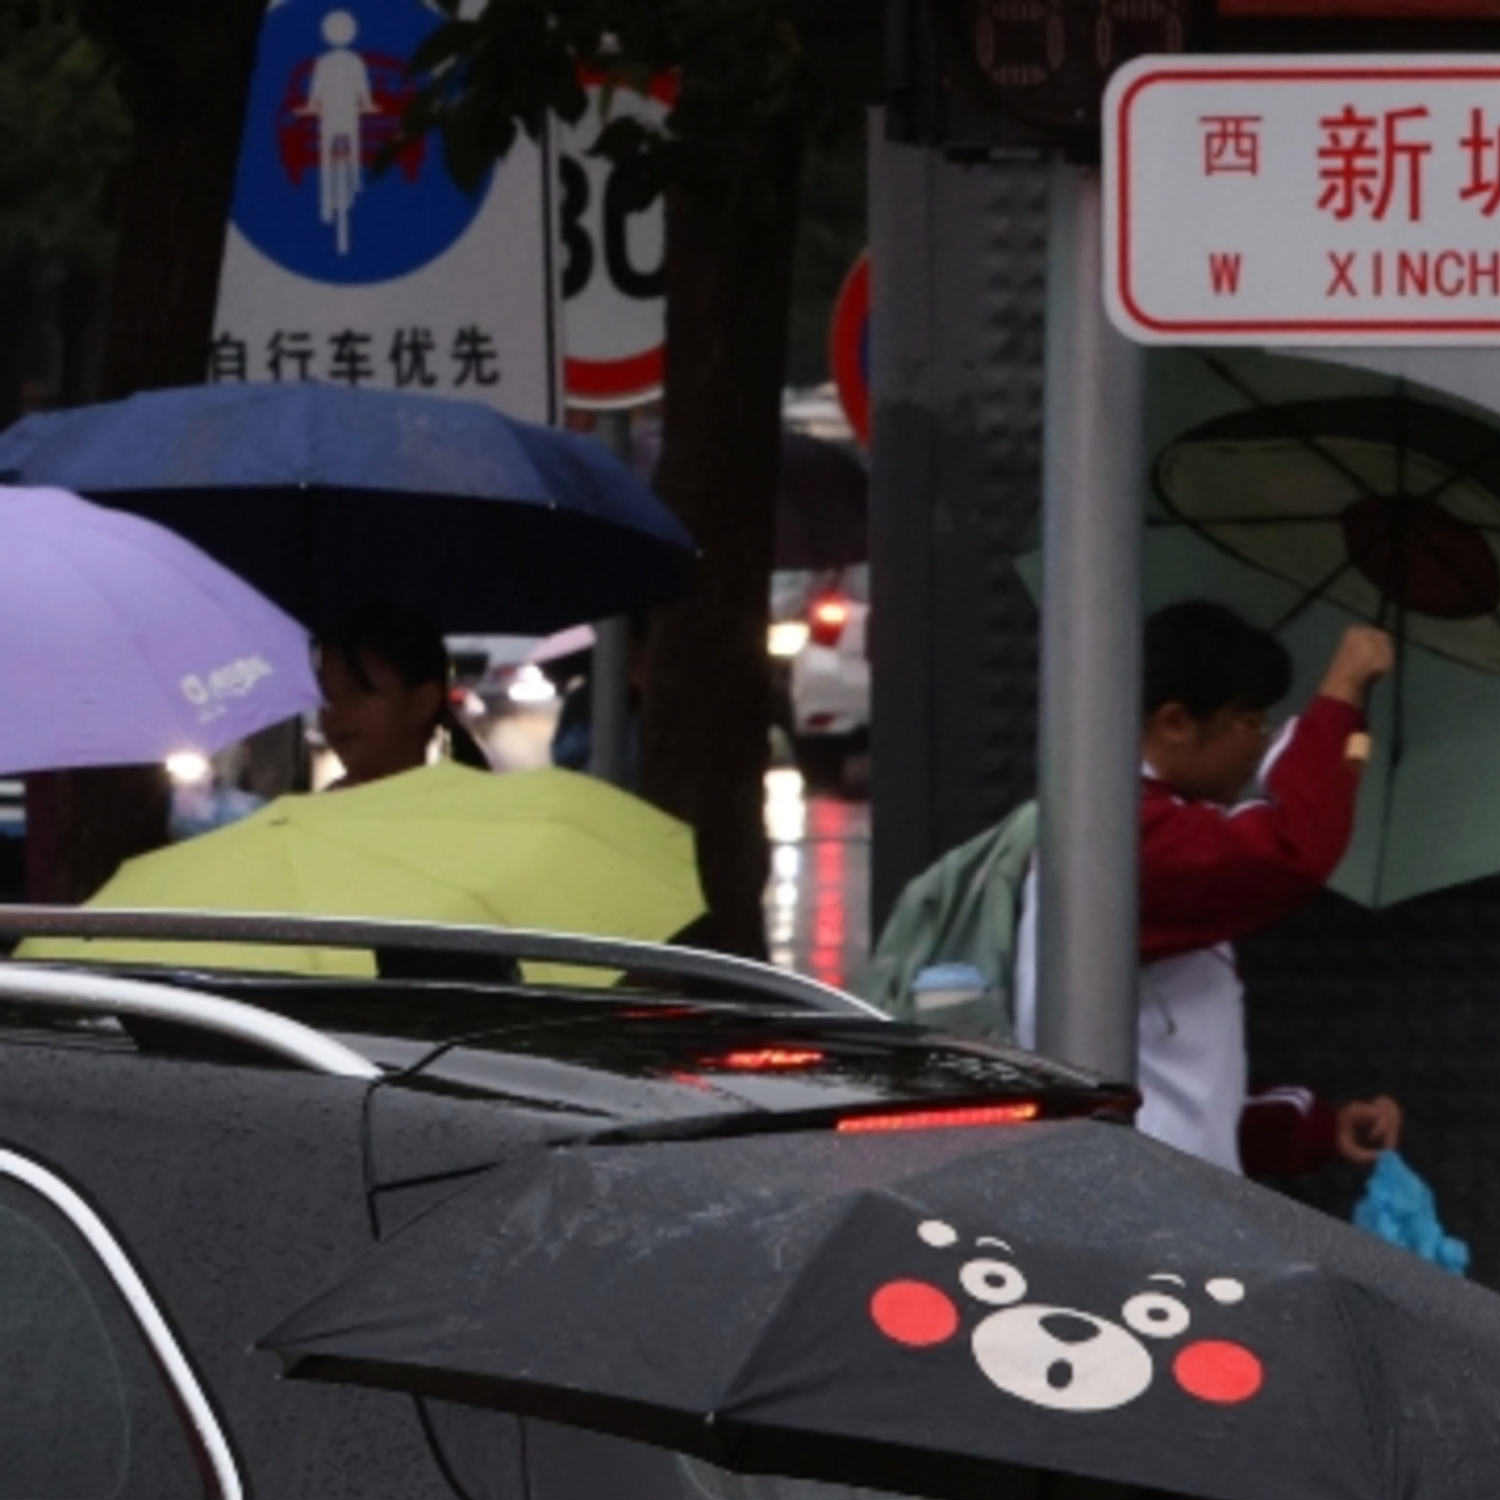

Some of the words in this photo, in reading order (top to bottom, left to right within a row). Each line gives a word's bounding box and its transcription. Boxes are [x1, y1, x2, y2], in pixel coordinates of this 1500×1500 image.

[1200, 115, 1262, 176] 西
[1209, 253, 1242, 295] W
[211, 325, 501, 388] 自行车优先
